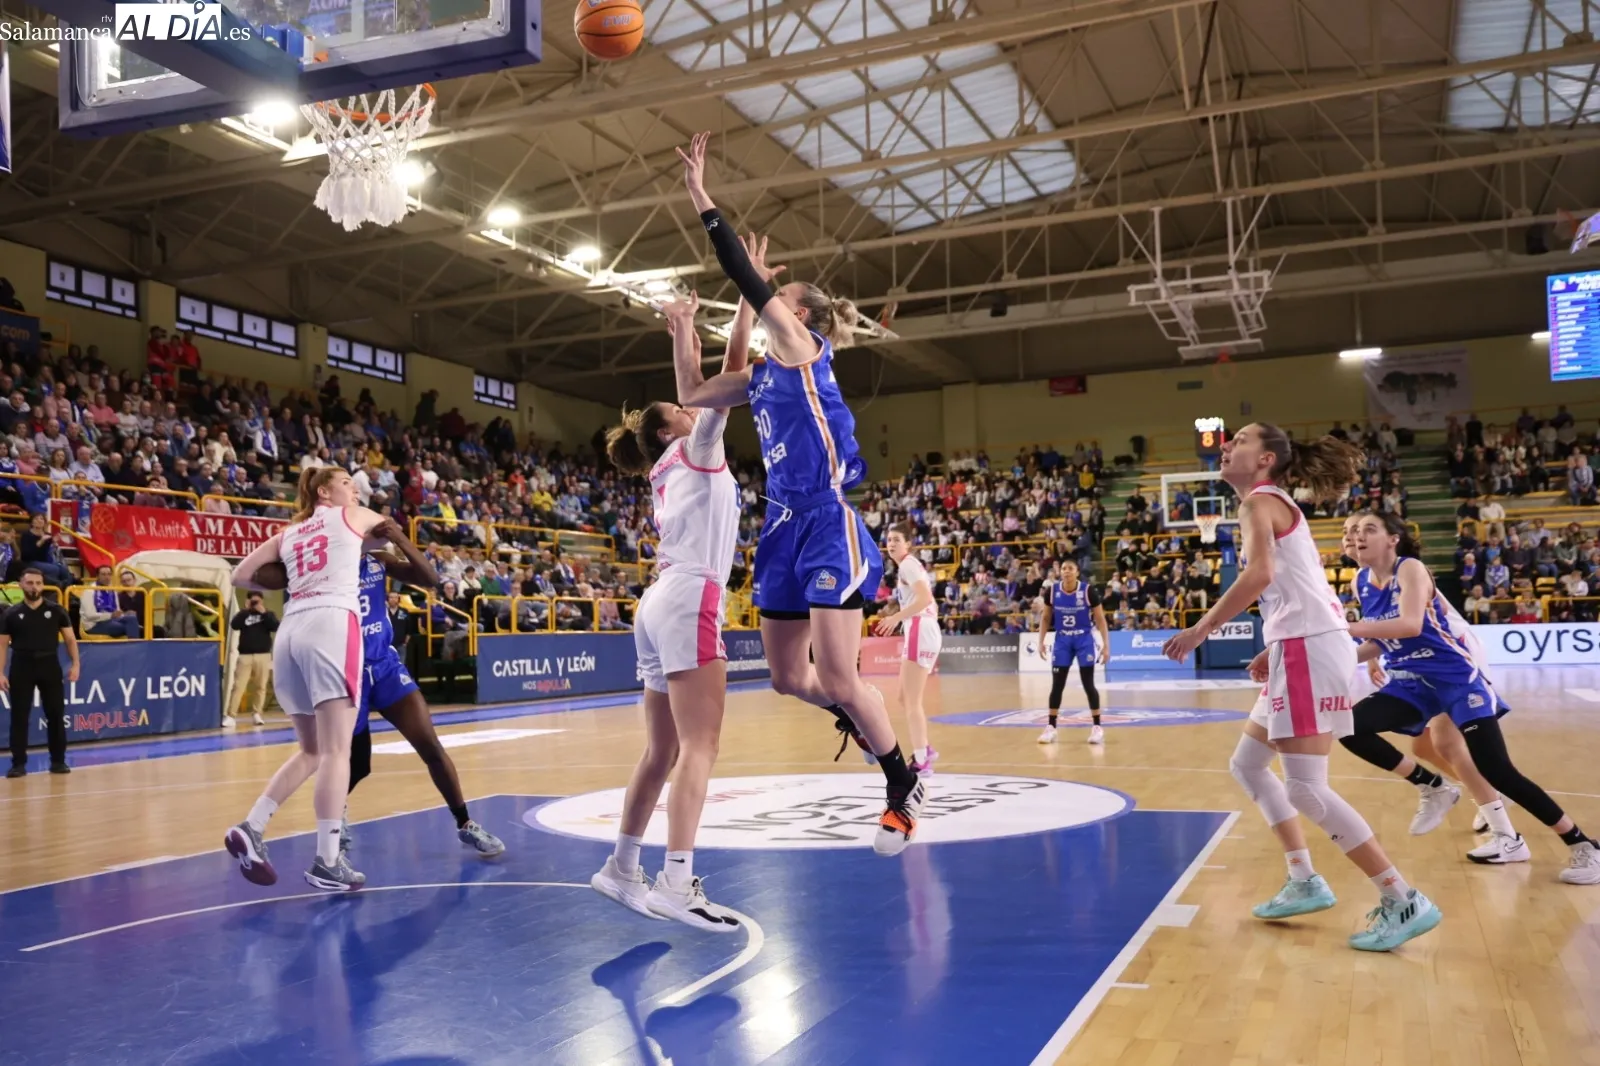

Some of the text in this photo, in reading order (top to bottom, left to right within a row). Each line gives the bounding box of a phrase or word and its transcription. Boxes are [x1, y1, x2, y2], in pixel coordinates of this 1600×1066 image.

[1202, 431, 1214, 447] 8
[196, 538, 217, 553] DE
[220, 540, 238, 555] LA
[293, 534, 329, 577] 13
[1062, 615, 1076, 627] 23
[1502, 628, 1600, 662] oyrs
[492, 650, 595, 677] CASTILLA Y LEÓN
[118, 678, 136, 707] Y
[146, 667, 206, 700] LEÓN
[522, 681, 537, 691] NOS
